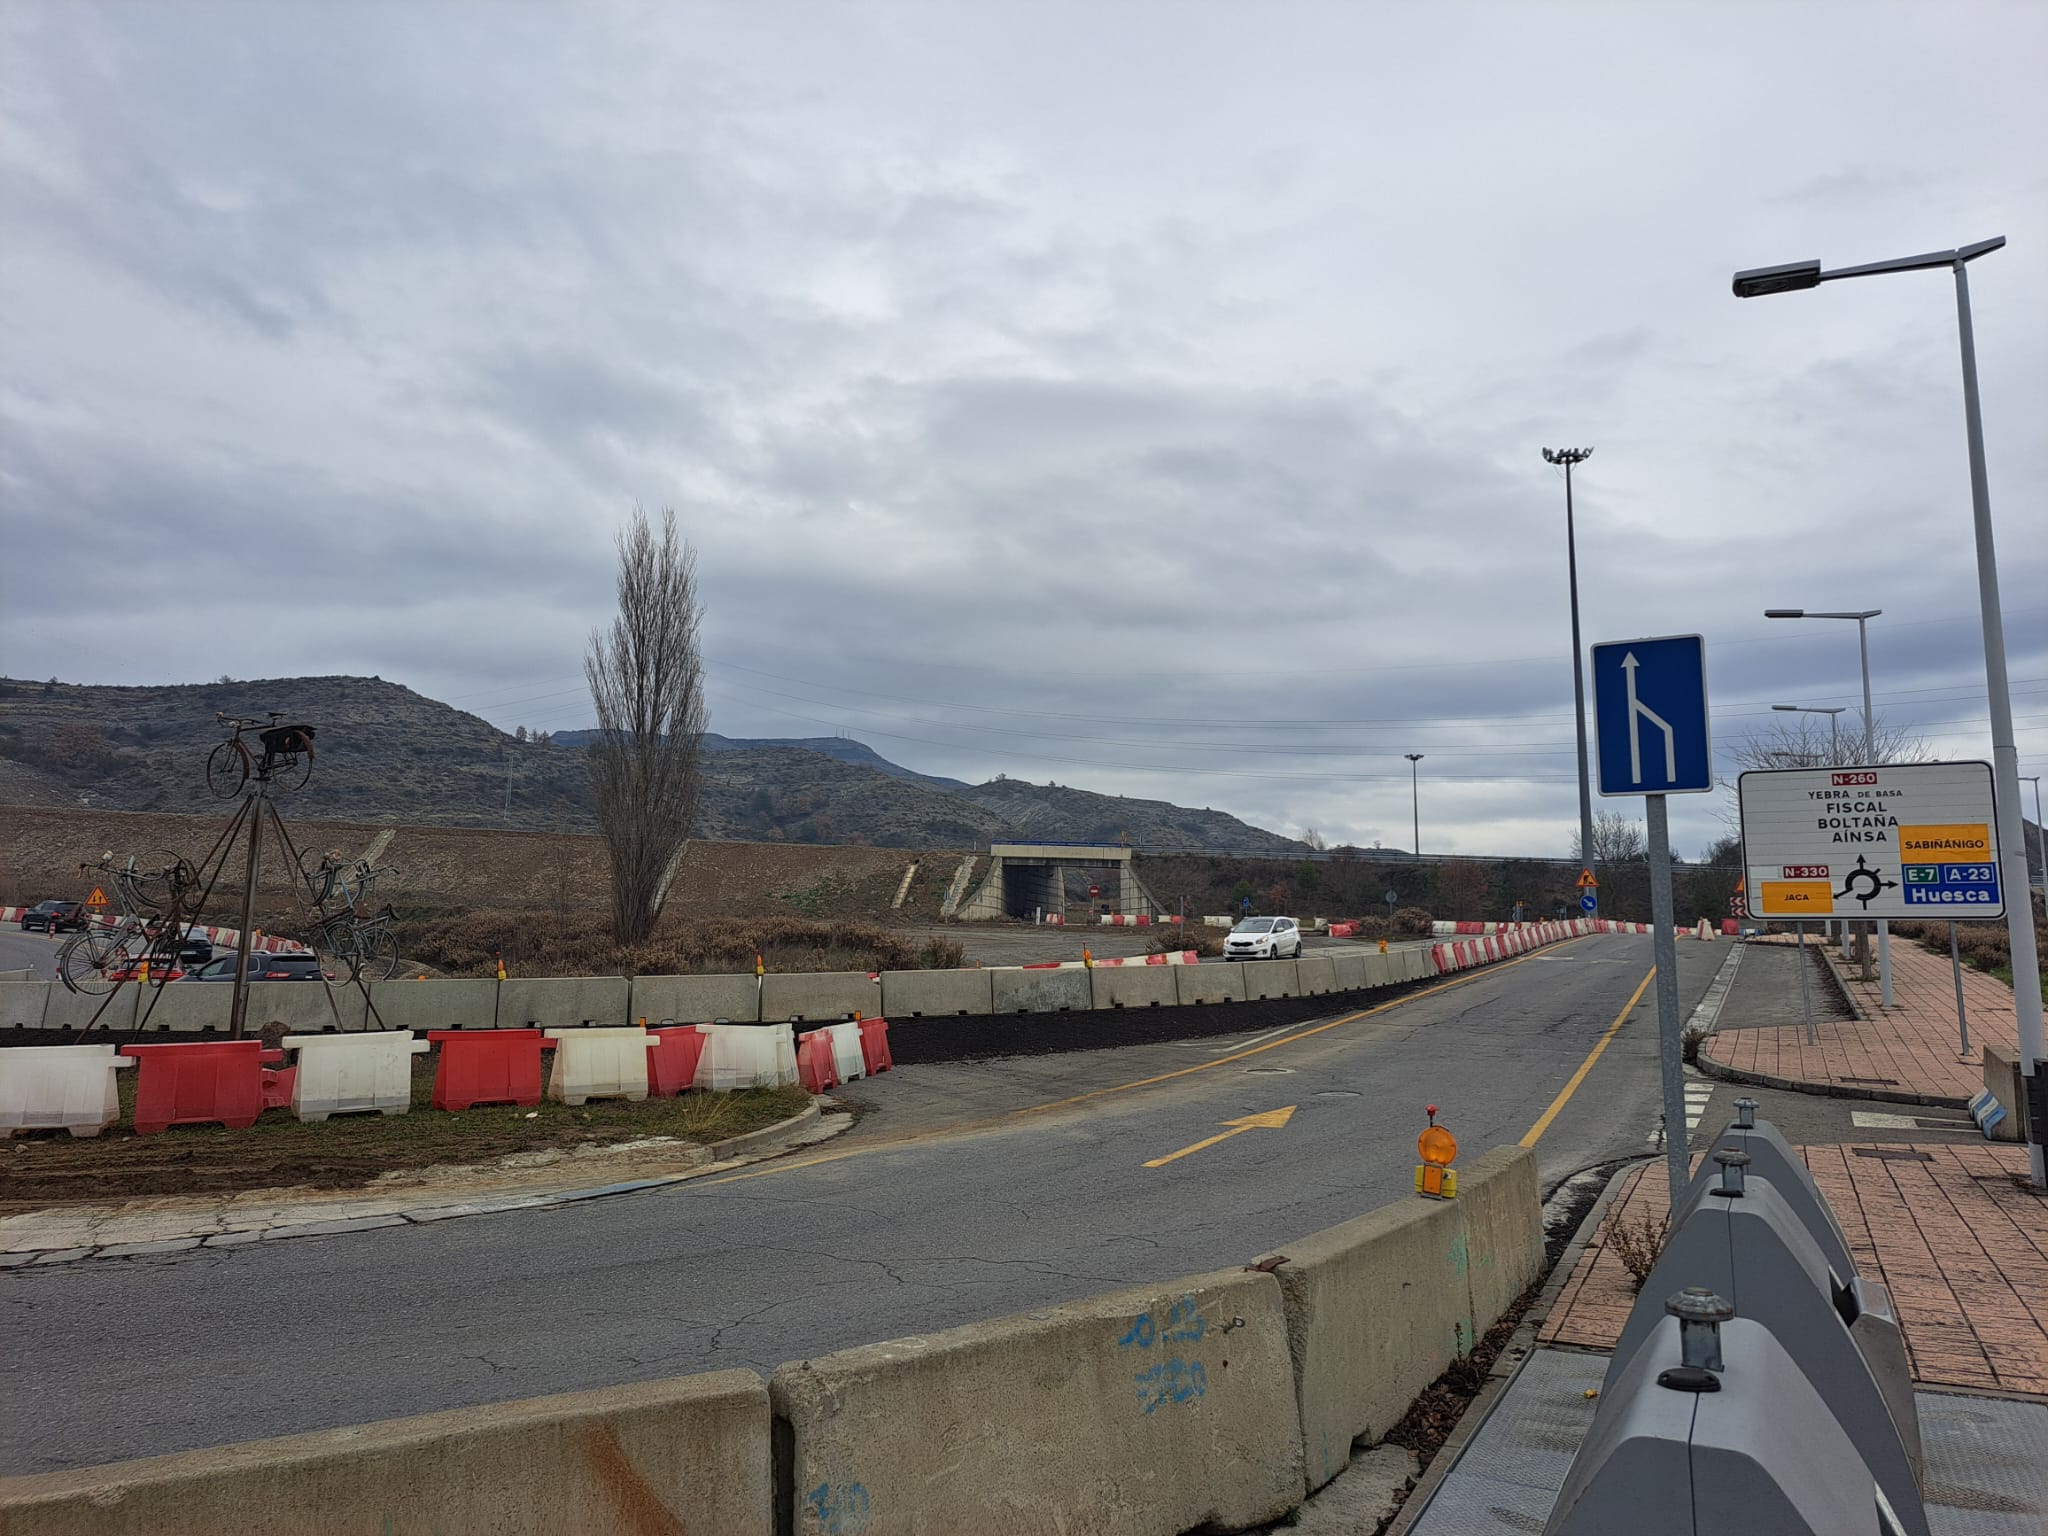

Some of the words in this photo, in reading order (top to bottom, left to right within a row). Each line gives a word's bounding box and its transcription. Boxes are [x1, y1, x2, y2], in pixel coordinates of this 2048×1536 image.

[1833, 773, 1876, 784] N-260
[1808, 790, 1850, 800] YEBRA
[1876, 790, 1903, 798] BASA
[1826, 801, 1887, 814] FISCAL
[1818, 814, 1899, 829] BOLTAÑA
[1832, 829, 1887, 843] AÍNSA
[1785, 867, 1827, 877] N-330
[1908, 869, 1935, 881] E-7
[1949, 868, 1990, 880] A-23
[1912, 888, 1990, 902] Huesca
